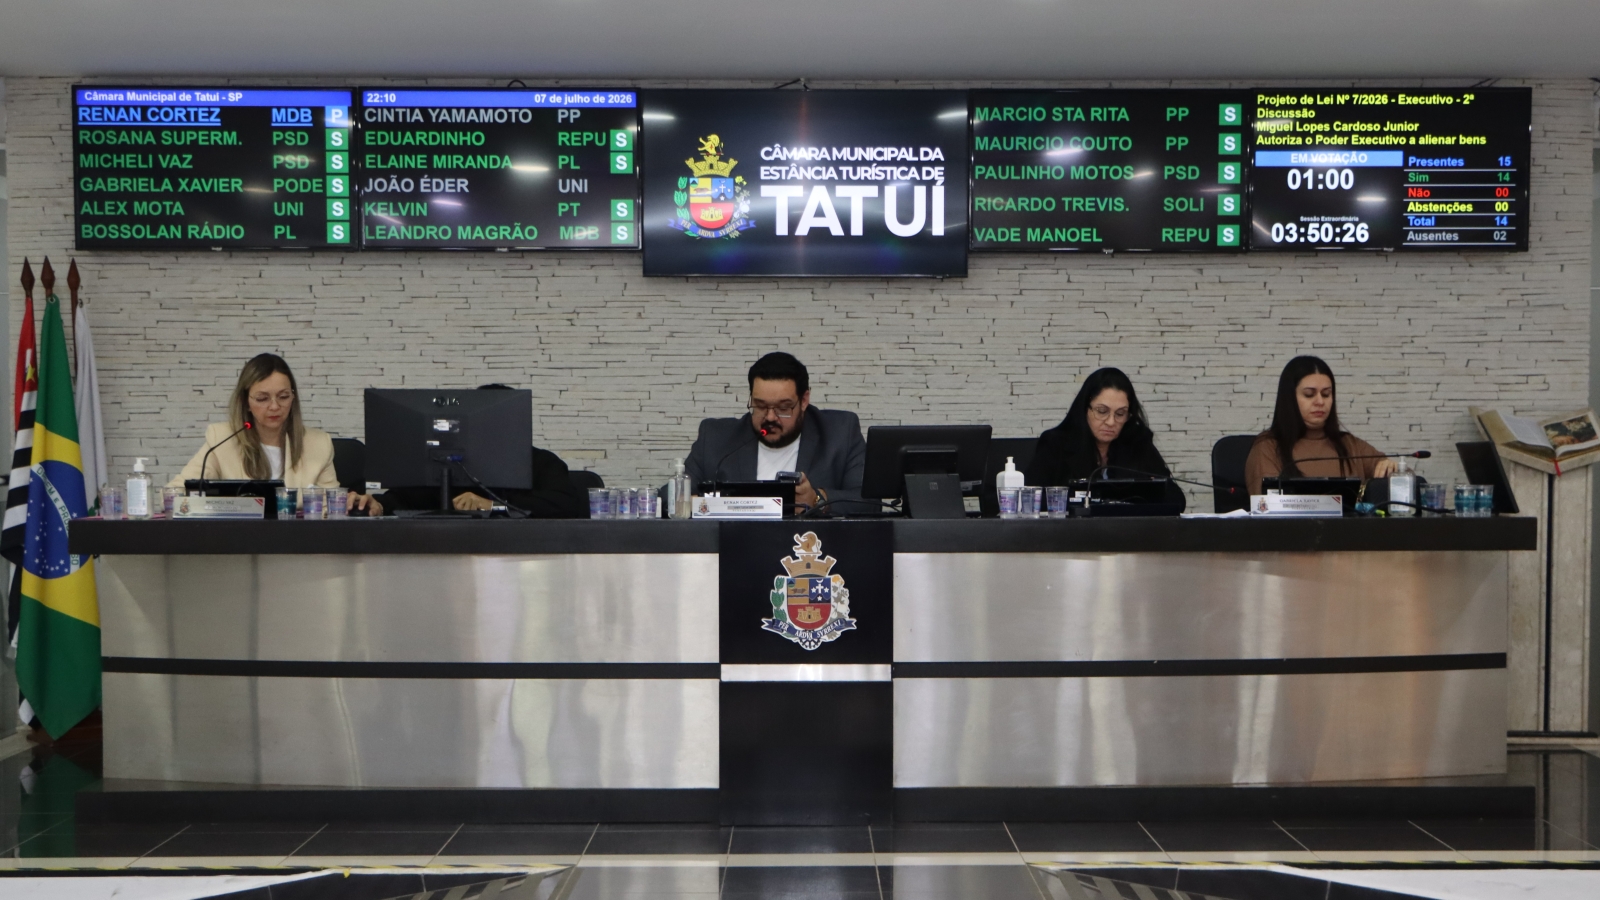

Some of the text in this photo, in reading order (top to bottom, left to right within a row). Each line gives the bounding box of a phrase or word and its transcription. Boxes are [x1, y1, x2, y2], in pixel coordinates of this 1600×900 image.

[84, 91, 124, 102] Câmara
[126, 92, 176, 104] Municipal
[178, 92, 192, 102] de
[228, 92, 242, 102] SP
[367, 94, 396, 103] 22:10
[534, 95, 632, 105] 07 de julho de 2026
[1257, 95, 1297, 106] Projeto
[1300, 95, 1314, 104] de
[1317, 95, 1334, 104] Lei
[1352, 95, 1388, 105] 7/2026
[1398, 95, 1453, 105] Executivo
[78, 107, 343, 123] RENAN CORTEZ MDB P
[365, 108, 581, 123] CINTIA YAMAMOTO PP
[975, 107, 1236, 121] MARCIO STA RITA PP S
[1257, 108, 1315, 118] Discussão
[1257, 122, 1419, 134] Miguel Lopes Cardoso Junior
[79, 131, 343, 146] ROSANA SUPERM. PSD S
[365, 132, 627, 147] EDUARDINHO REPU S
[975, 136, 1236, 151] MAURICIO COUTO PP S
[1256, 135, 1302, 145] Autoriza
[1316, 135, 1348, 145] Poder
[1351, 135, 1405, 145] Executivo
[1419, 135, 1456, 145] alienar
[1459, 136, 1486, 145] bens
[760, 143, 944, 161] CÂMARA MUNICIPAL DA
[1291, 151, 1367, 165] EM VOTAÇÃO
[79, 154, 343, 169] MICHELI VAZ PSD S
[365, 155, 627, 170] ELAINE MIRANDA PL S
[1409, 157, 1511, 167] Presentes 15
[760, 164, 944, 180] ESTÂNCIA TURÍSTICA DE
[975, 166, 1235, 180] PAULINHO MOTOS PSD S
[1408, 173, 1510, 182] Sim 14
[80, 178, 344, 193] GABRIELA XAVIER PODE S
[365, 175, 588, 193] JOÃO ÉDER UNI
[1287, 169, 1354, 190] 01:00
[1408, 188, 1509, 198] Não 00
[80, 201, 344, 216] ALEX MOTA UNI S
[365, 203, 627, 217] KELVIN PT S
[760, 180, 945, 237] TATUÍ
[975, 197, 1235, 212] RICARDO TREVIS. SOLI S
[1407, 202, 1508, 214] Abstenções 00
[1408, 216, 1507, 226] Total 14
[82, 221, 344, 240] BOSSOLAN RÁDIO PL S
[365, 222, 628, 240] LEANDRO MAGRÃO MDB S
[974, 228, 1234, 242] VADE MANOEL REPU S
[1271, 223, 1369, 243] 03:50:26
[1407, 231, 1506, 241] Ausentes 02
